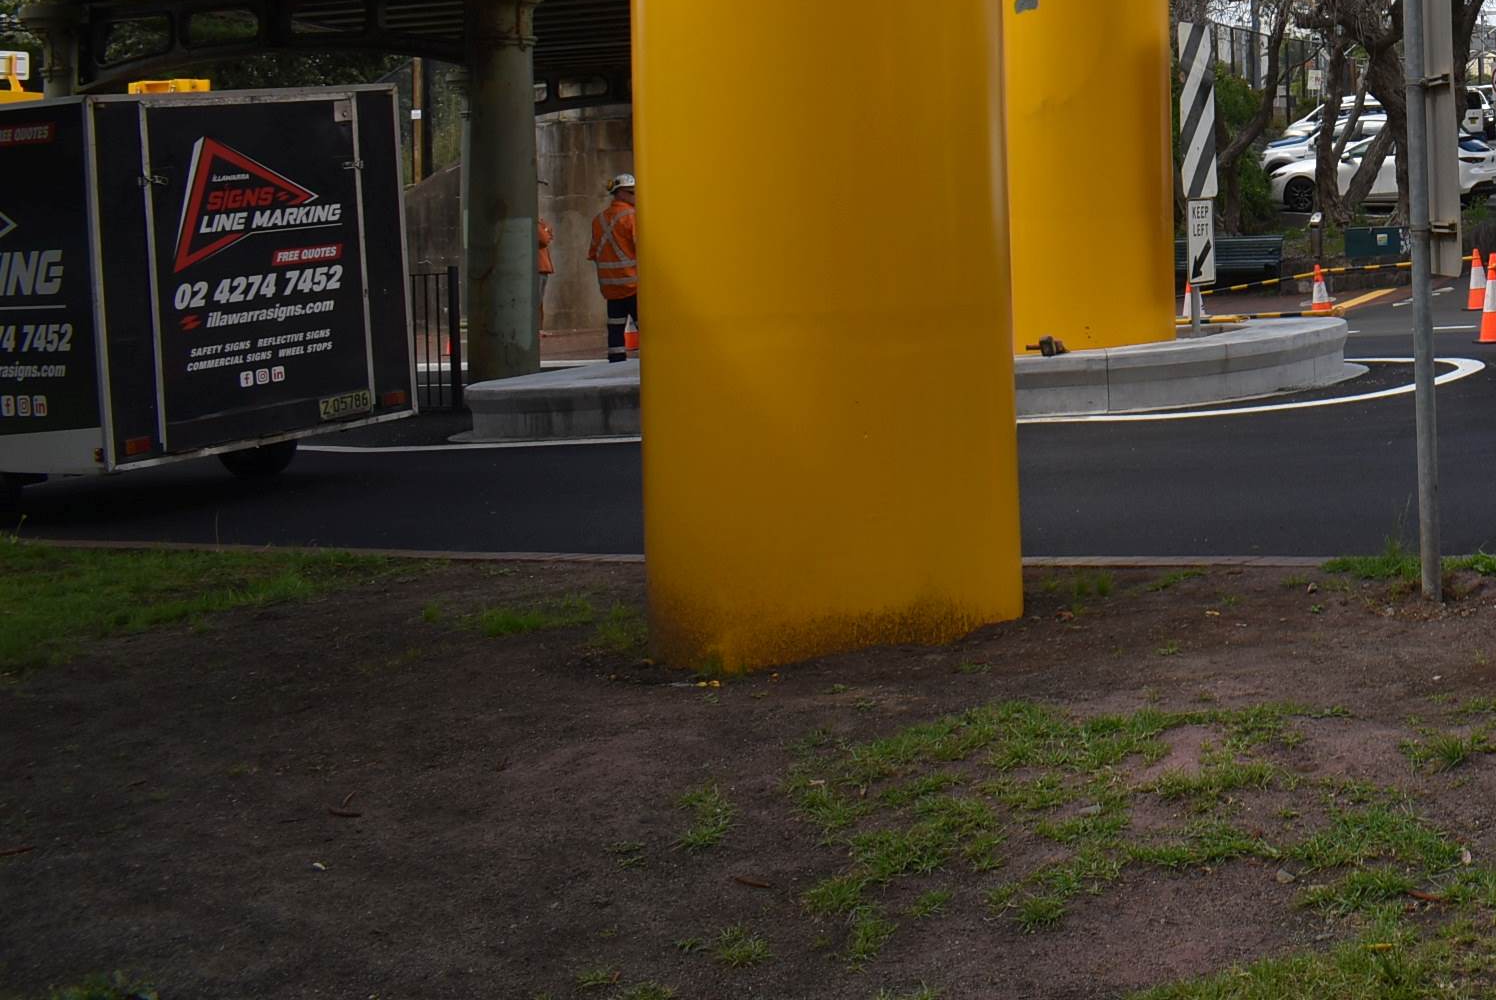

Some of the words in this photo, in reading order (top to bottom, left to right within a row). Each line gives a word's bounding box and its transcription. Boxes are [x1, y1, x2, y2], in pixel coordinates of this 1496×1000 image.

[15, 125, 48, 141] QUOTES
[207, 186, 275, 212] SIGNS
[1192, 206, 1209, 219] KEEP
[199, 211, 248, 234] LINE
[251, 203, 342, 229] MARKING
[1193, 223, 1209, 237] LEFT
[276, 250, 300, 263] FREE
[301, 246, 337, 260] QUOTES
[174, 281, 209, 310] 02
[213, 272, 277, 304] 4274
[283, 264, 344, 296] 7452
[206, 300, 335, 328] illawarrasigns.com
[21, 323, 73, 353] 7452
[190, 343, 223, 358] SAFETY
[225, 340, 251, 352] SIGNS
[257, 332, 304, 348] REFLECTIVE
[305, 328, 331, 341] SIGNS
[186, 356, 244, 372] COMMERCIAL
[246, 350, 272, 363] SIGNS
[278, 345, 305, 358] WHEEL
[307, 341, 333, 354] STOPS
